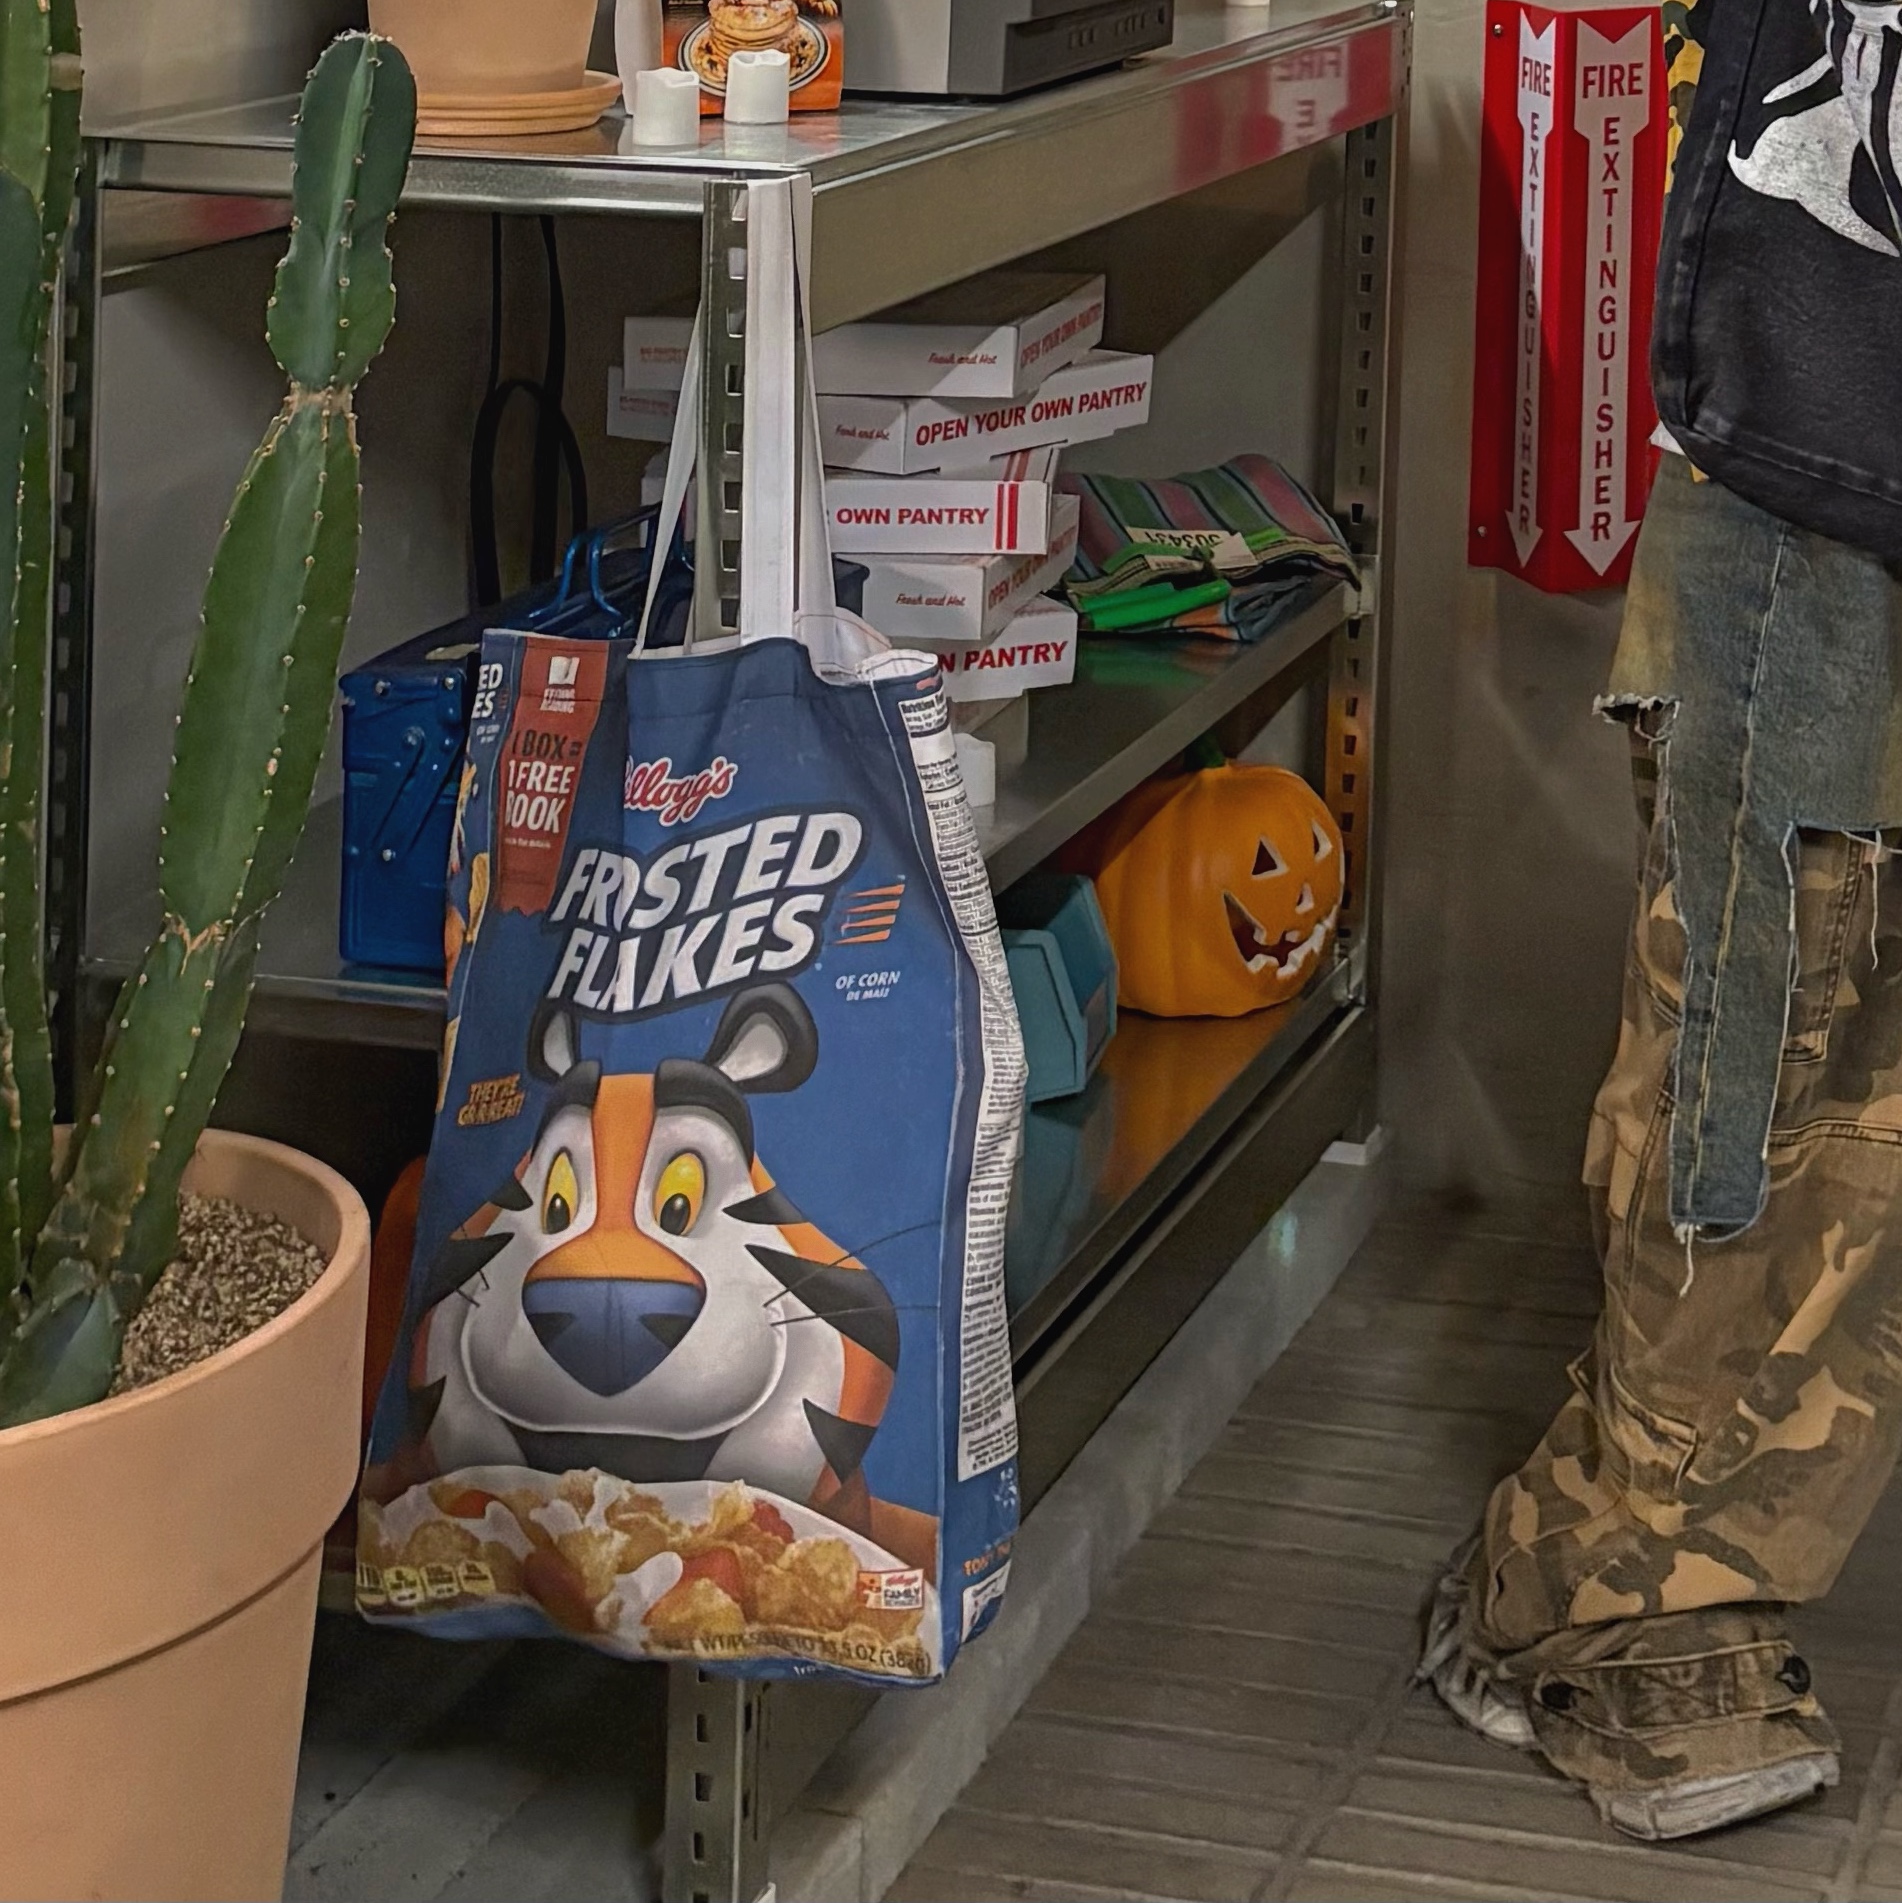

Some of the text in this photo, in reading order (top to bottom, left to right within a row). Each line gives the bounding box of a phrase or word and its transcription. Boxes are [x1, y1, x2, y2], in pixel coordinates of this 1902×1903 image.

[1522, 56, 1552, 98] FIRE
[1582, 61, 1645, 100] FIRE
[1518, 111, 1541, 534] EXTINGUISHER
[1592, 116, 1622, 543] EXTINGUISHER
[928, 352, 997, 365] Fresh and Hot
[1020, 342, 1041, 369] OPEN
[916, 382, 1147, 446] OPEN YOUR OWN PANTRY
[836, 508, 989, 525] OWN PANTRY
[896, 593, 966, 607] Fresh and Hot
[964, 641, 1068, 671] PANTRY
[522, 729, 568, 761] BOX
[516, 761, 575, 794] FREE
[549, 812, 863, 934] FROSTED
[546, 893, 825, 1014] FLAKES
[835, 970, 901, 990] OF CORN
[855, 1645, 877, 1664] OZ
